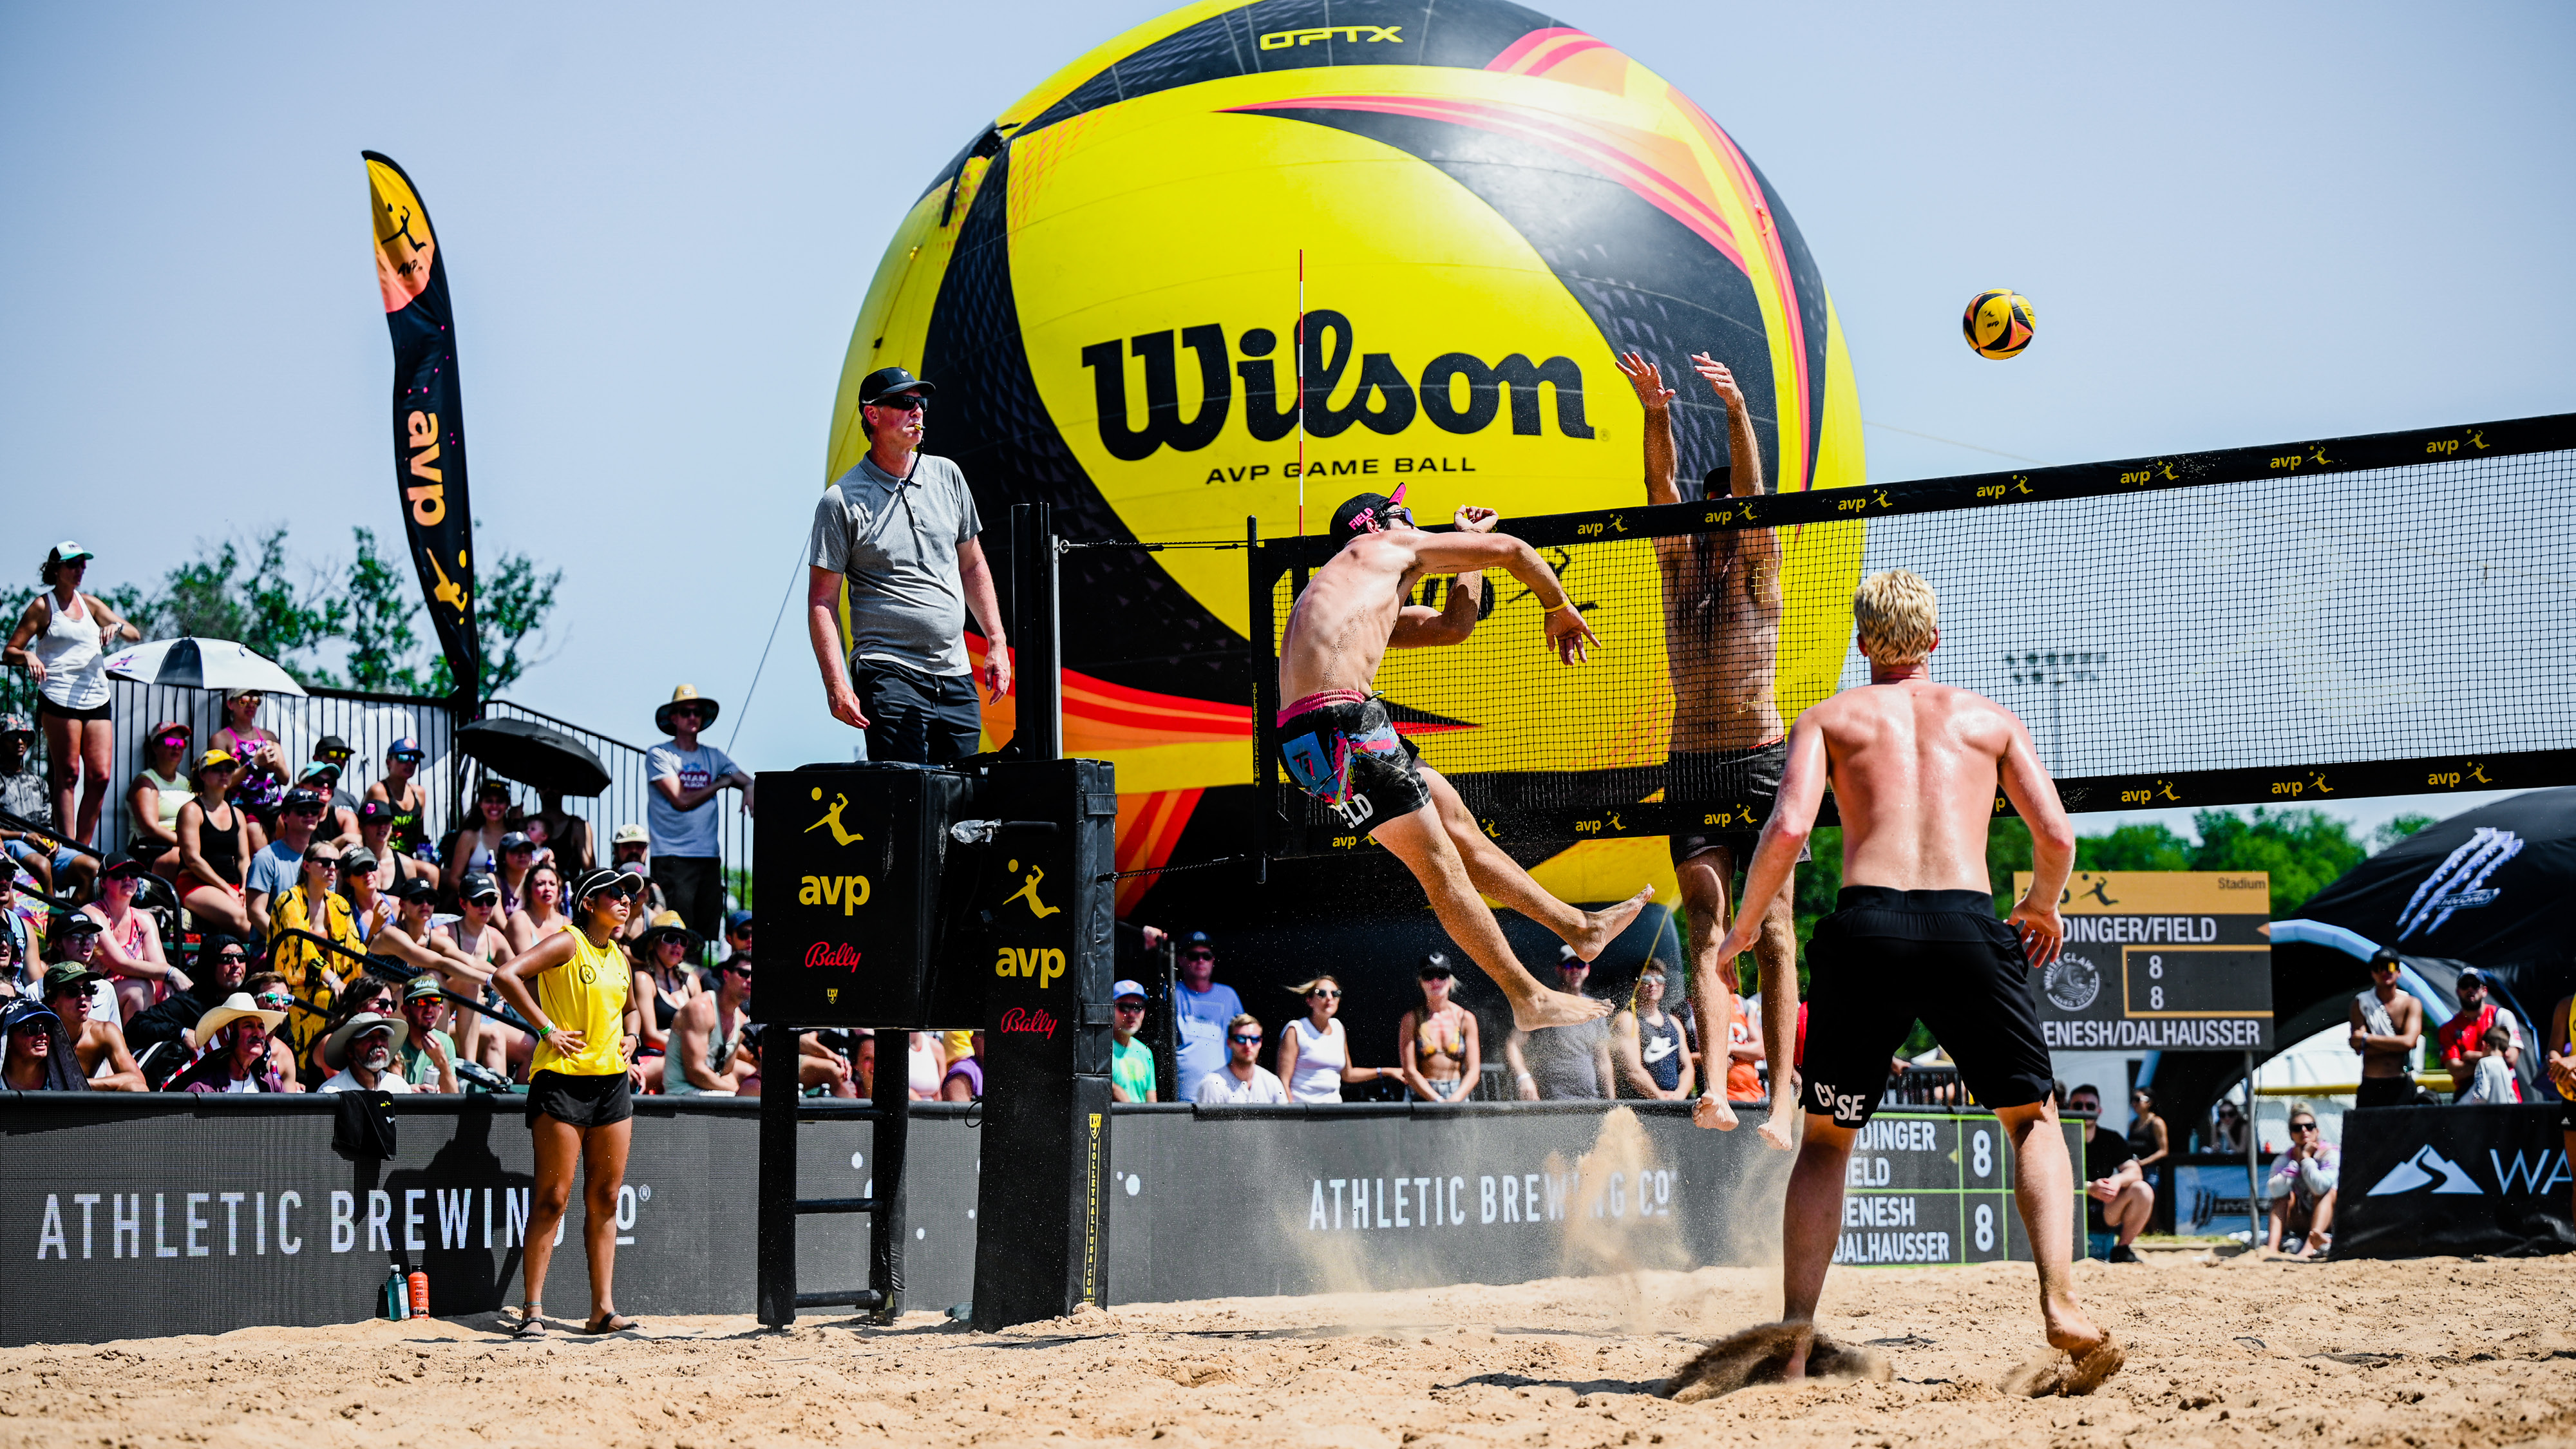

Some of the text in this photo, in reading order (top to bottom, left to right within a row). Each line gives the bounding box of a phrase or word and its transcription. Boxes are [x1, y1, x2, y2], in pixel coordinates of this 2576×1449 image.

[1260, 25, 1404, 50] OPTX
[1081, 308, 1595, 462] Wilson
[2426, 439, 2459, 455] avp
[407, 410, 446, 527] avp
[1206, 457, 1476, 486] AVP GAME BALL
[2270, 455, 2302, 471] avp
[2120, 470, 2151, 486] avp
[1976, 484, 2007, 499] avp
[1837, 497, 1866, 513] avp
[1348, 507, 1374, 531] FIELD
[1705, 510, 1733, 525] avp
[1577, 522, 1604, 538] avp
[2271, 781, 2304, 797] avp
[2428, 772, 2461, 788] avp
[2121, 789, 2152, 805] avp
[1575, 819, 1602, 835] avp
[1704, 812, 1732, 828] avp
[1332, 835, 1358, 850] avp
[2218, 876, 2266, 889] Stadium
[798, 875, 871, 916] avp
[2063, 916, 2217, 943] DINGER/FIELD
[804, 941, 862, 973] Bally
[995, 947, 1066, 989] avp
[2149, 955, 2163, 979] 8
[2150, 986, 2164, 1010] 8
[1000, 1007, 1058, 1039] Bally
[2040, 1020, 2260, 1046] ENESH/DALHAUSSER
[1973, 1129, 1993, 1179] 8
[1309, 1175, 1466, 1231] ATHLETIC
[1480, 1171, 1626, 1224] BREWG
[1842, 1196, 1917, 1227] ENESH
[35, 1189, 303, 1261] ATHLETIC
[1975, 1203, 1994, 1253] 8
